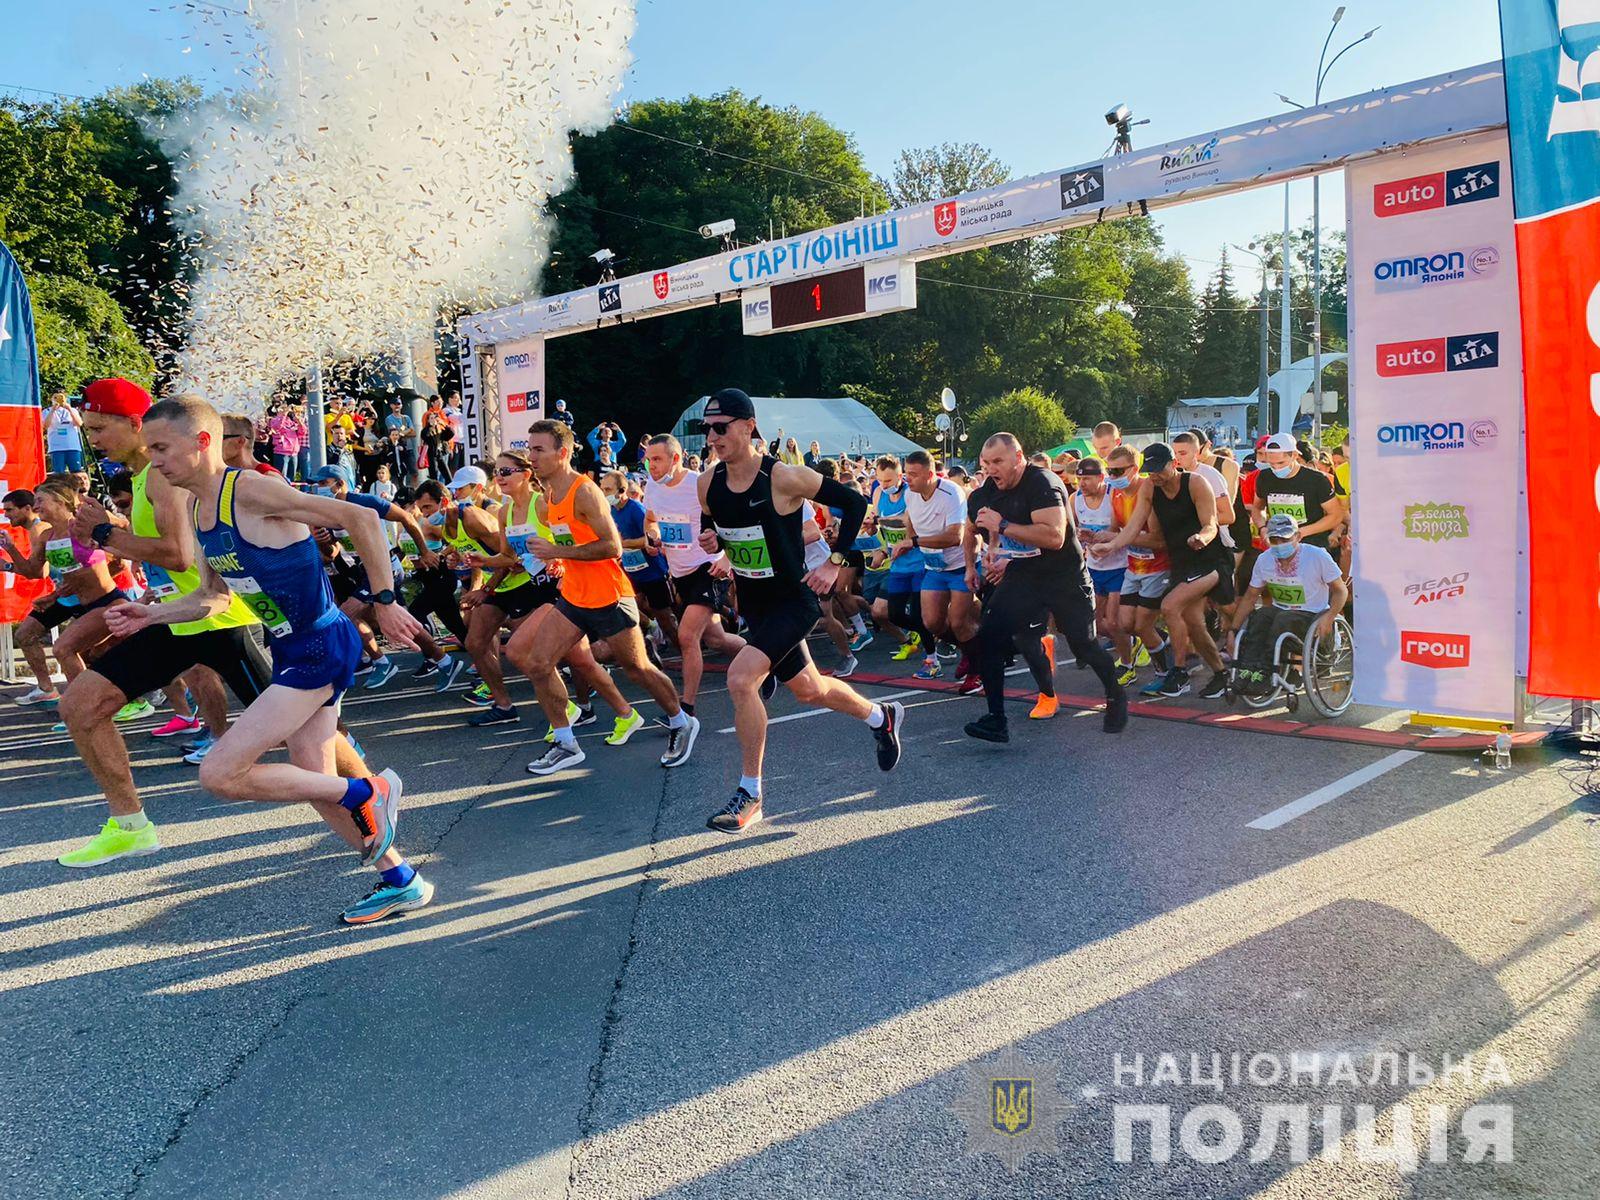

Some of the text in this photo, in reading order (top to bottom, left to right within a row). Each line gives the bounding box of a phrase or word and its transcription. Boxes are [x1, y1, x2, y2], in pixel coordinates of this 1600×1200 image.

[1063, 176, 1101, 206] RIA
[1384, 174, 1495, 207] auto RIA
[960, 199, 1004, 217] Вінницька
[960, 208, 1013, 228] міська рада
[729, 217, 899, 283] СТАРТ/ФІНІШ
[1374, 251, 1465, 280] OMRON
[868, 274, 897, 296] IKS
[1421, 270, 1465, 284] Японія
[600, 291, 619, 311] RIA
[811, 283, 822, 312] 1
[745, 300, 769, 319] IKS
[1385, 343, 1494, 367] auto RIA
[509, 399, 524, 408] auto
[1377, 422, 1465, 444] OMRON
[1423, 439, 1465, 451] Японія
[1406, 640, 1465, 659] ГРОШ
